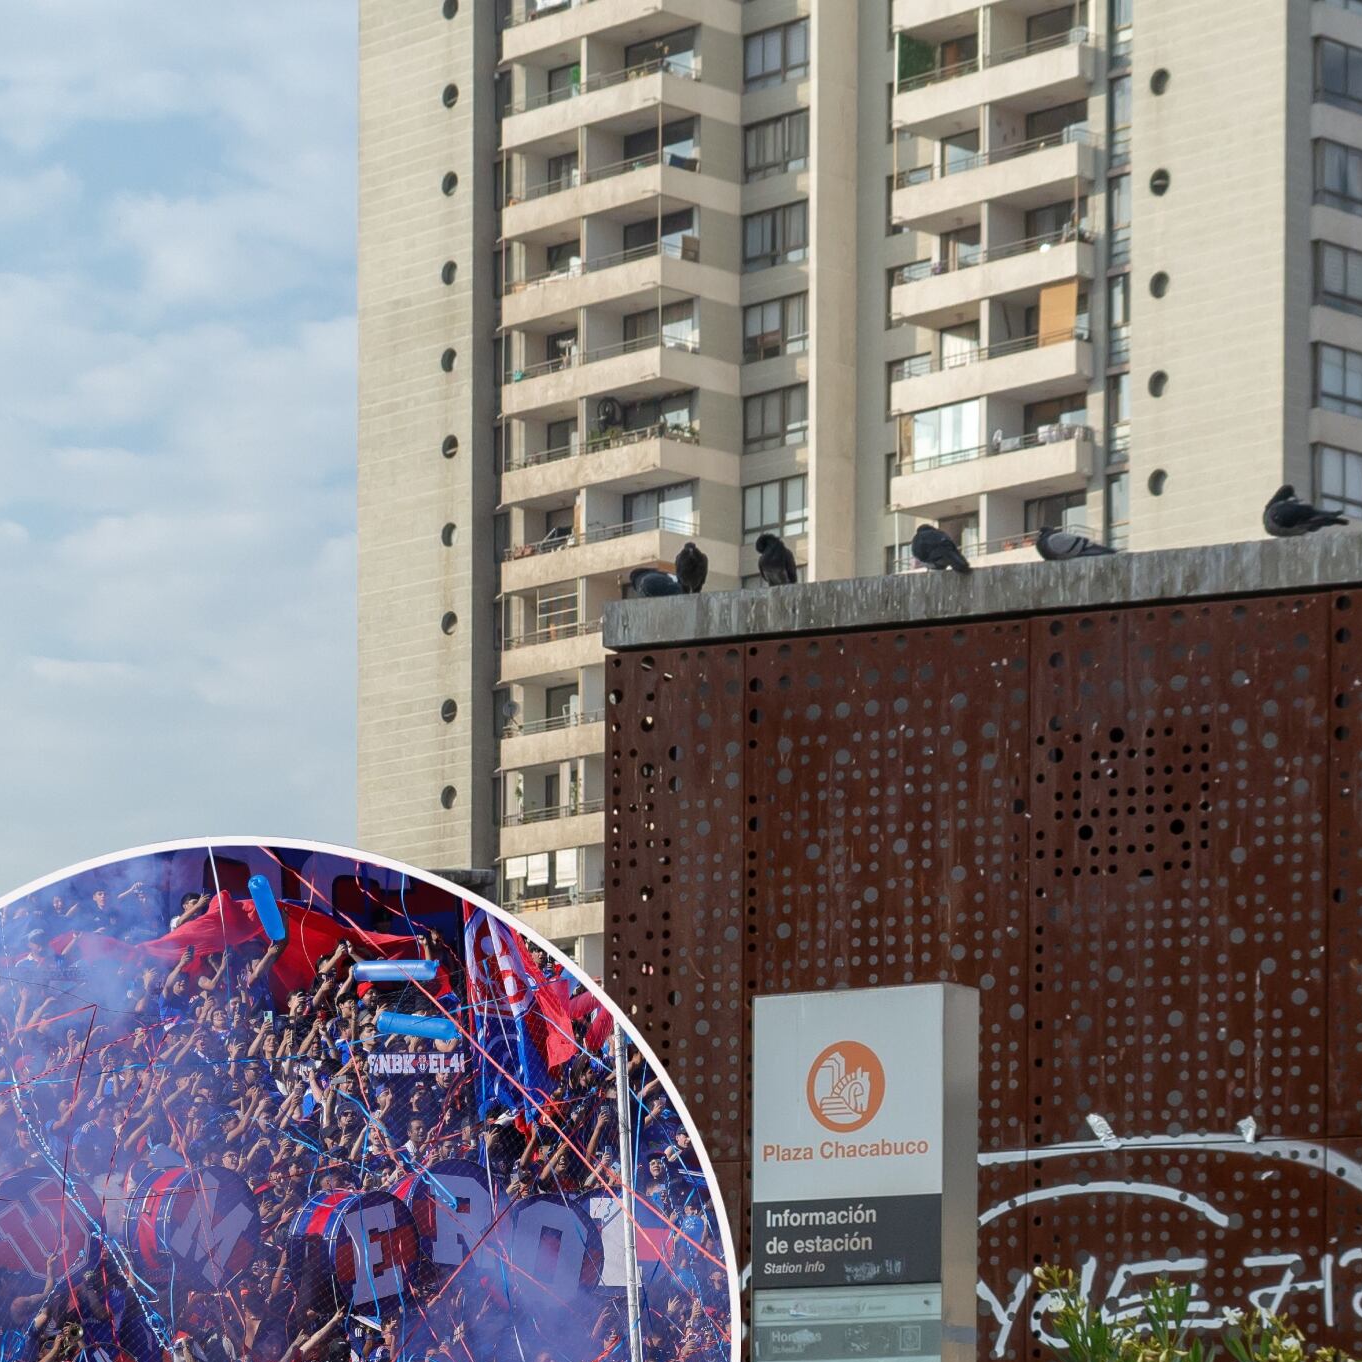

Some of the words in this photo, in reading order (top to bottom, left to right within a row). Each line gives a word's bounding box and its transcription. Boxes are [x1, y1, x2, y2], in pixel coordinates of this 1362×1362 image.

[763, 1145, 814, 1162] Plaza
[820, 1139, 929, 1160] Chacabuco
[766, 1204, 877, 1228] Información
[766, 1237, 788, 1255] de
[793, 1232, 873, 1253] estación
[764, 1262, 802, 1274] Station
[805, 1261, 825, 1273] info
